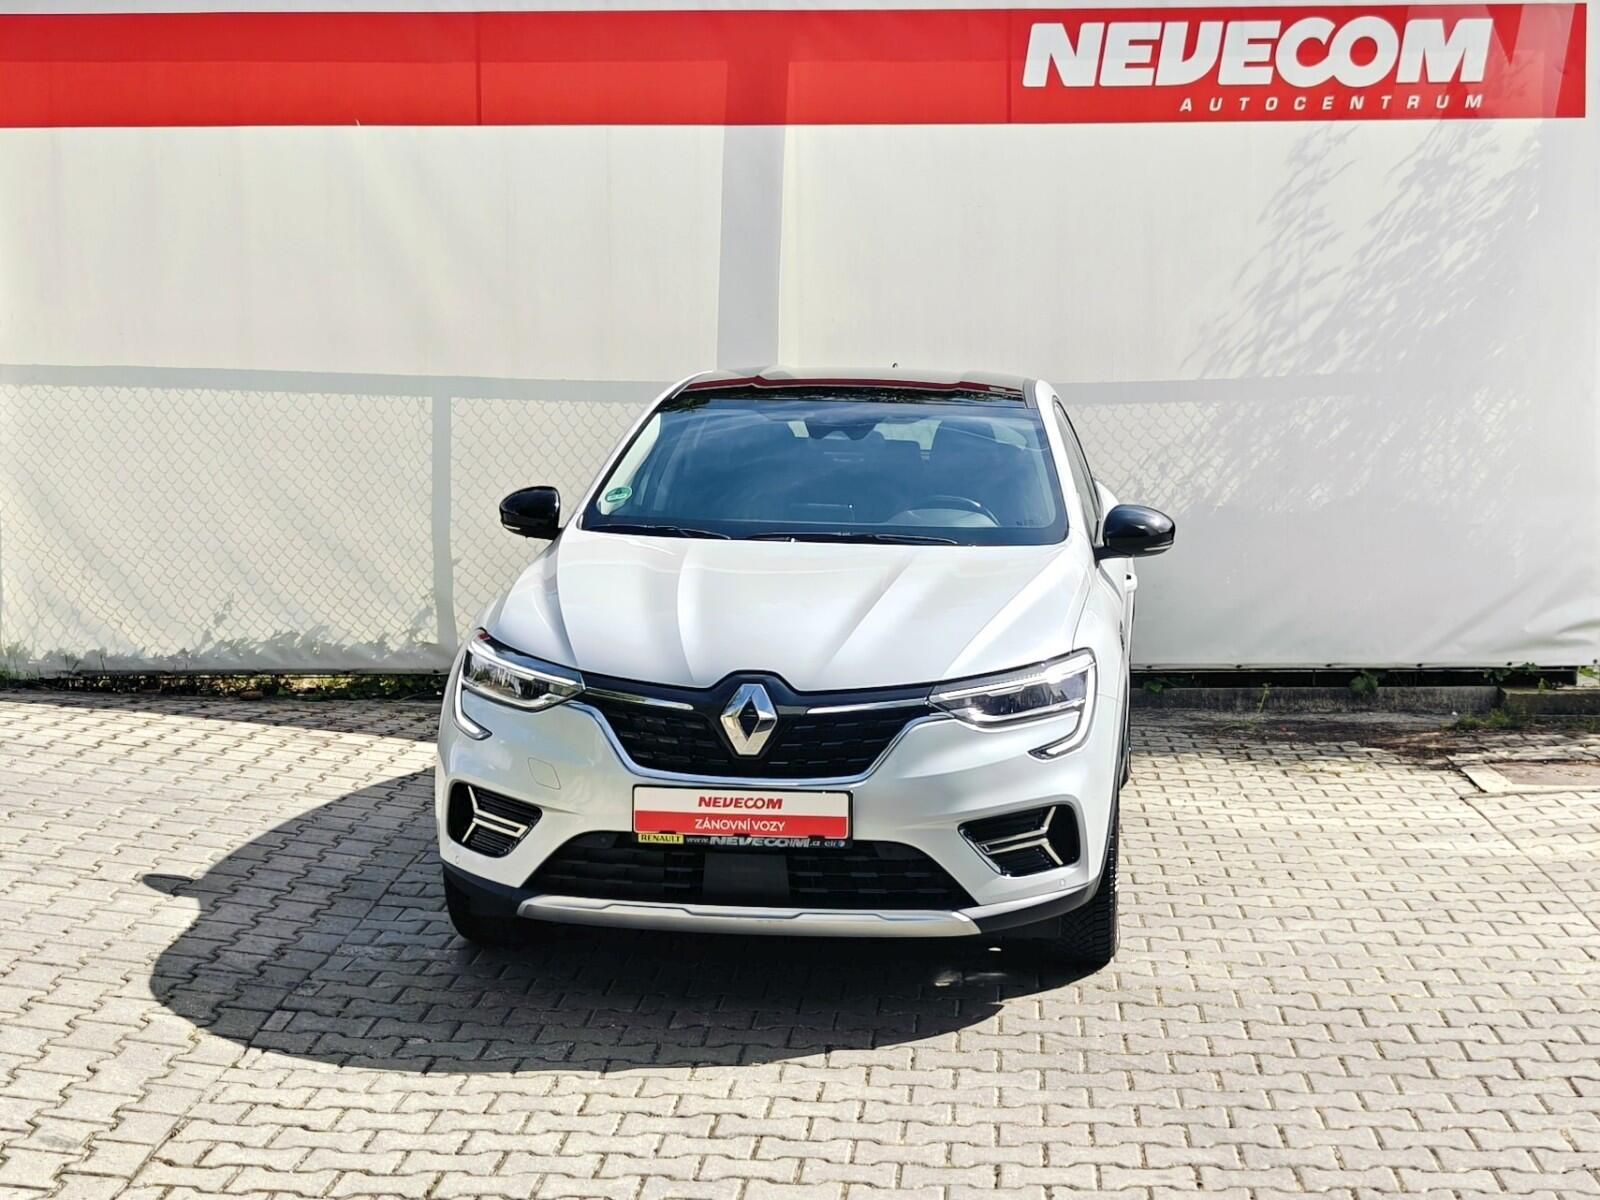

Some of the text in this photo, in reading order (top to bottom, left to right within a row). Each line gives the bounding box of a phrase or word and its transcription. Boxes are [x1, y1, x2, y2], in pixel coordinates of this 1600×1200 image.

[1023, 16, 1494, 88] NEVECOM
[1180, 94, 1484, 112] AUTOCENTRUM
[698, 796, 783, 810] NEVECOM
[695, 817, 785, 832] ZÁNOVNÍ VOZY
[641, 833, 681, 842] RENAULT
